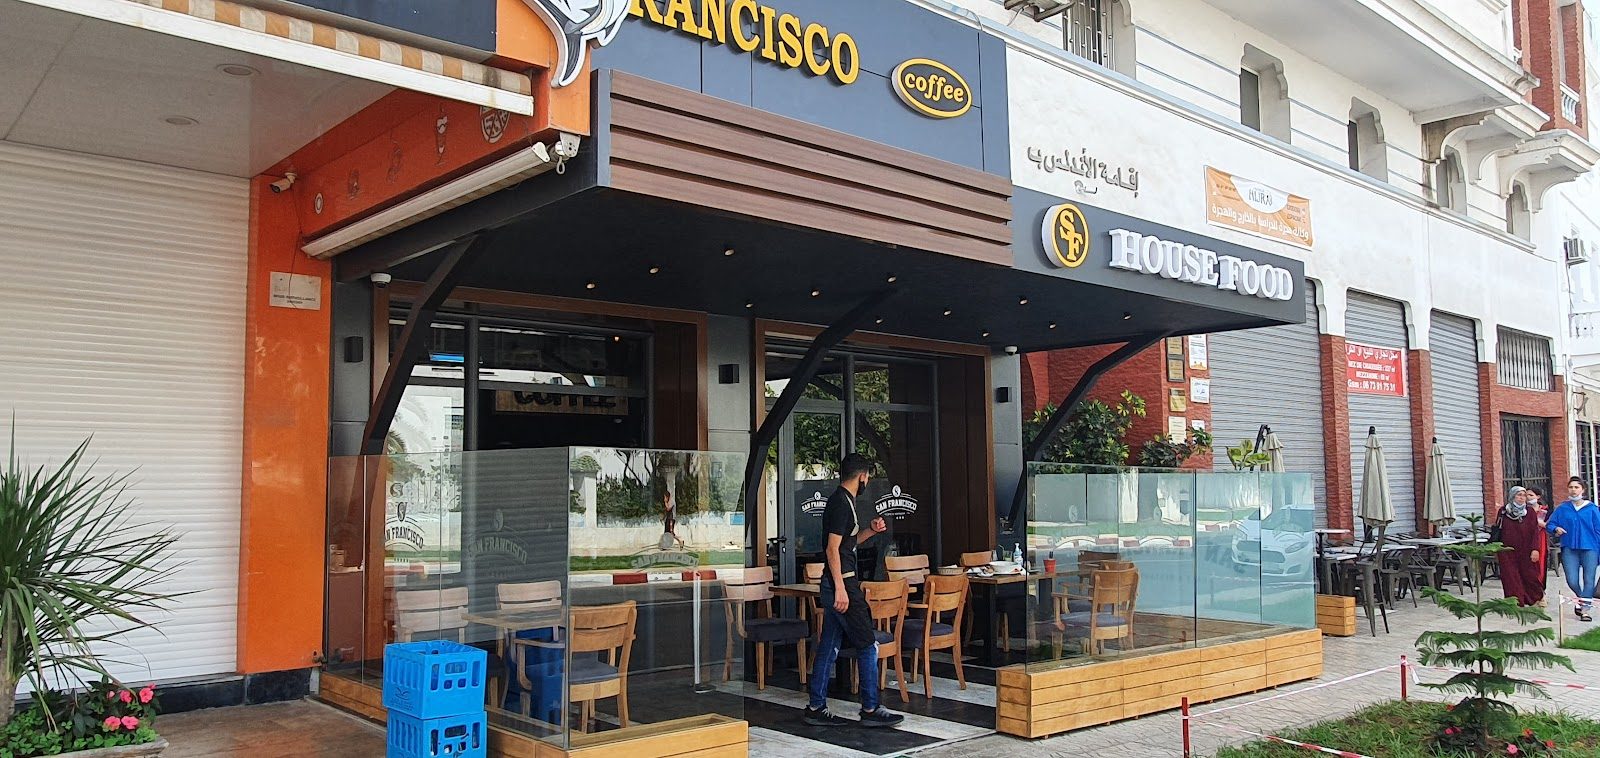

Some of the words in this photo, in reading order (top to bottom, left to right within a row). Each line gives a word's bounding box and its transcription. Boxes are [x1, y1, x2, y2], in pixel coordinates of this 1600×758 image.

[904, 73, 964, 102] coffee
[1108, 227, 1219, 287] HOUSE
[1217, 254, 1294, 301] FOOD
[875, 500, 888, 513] SAN
[888, 499, 917, 511] FRANCISCO
[391, 526, 424, 549] FRANCISCO
[485, 536, 528, 564] FRANCISCO
